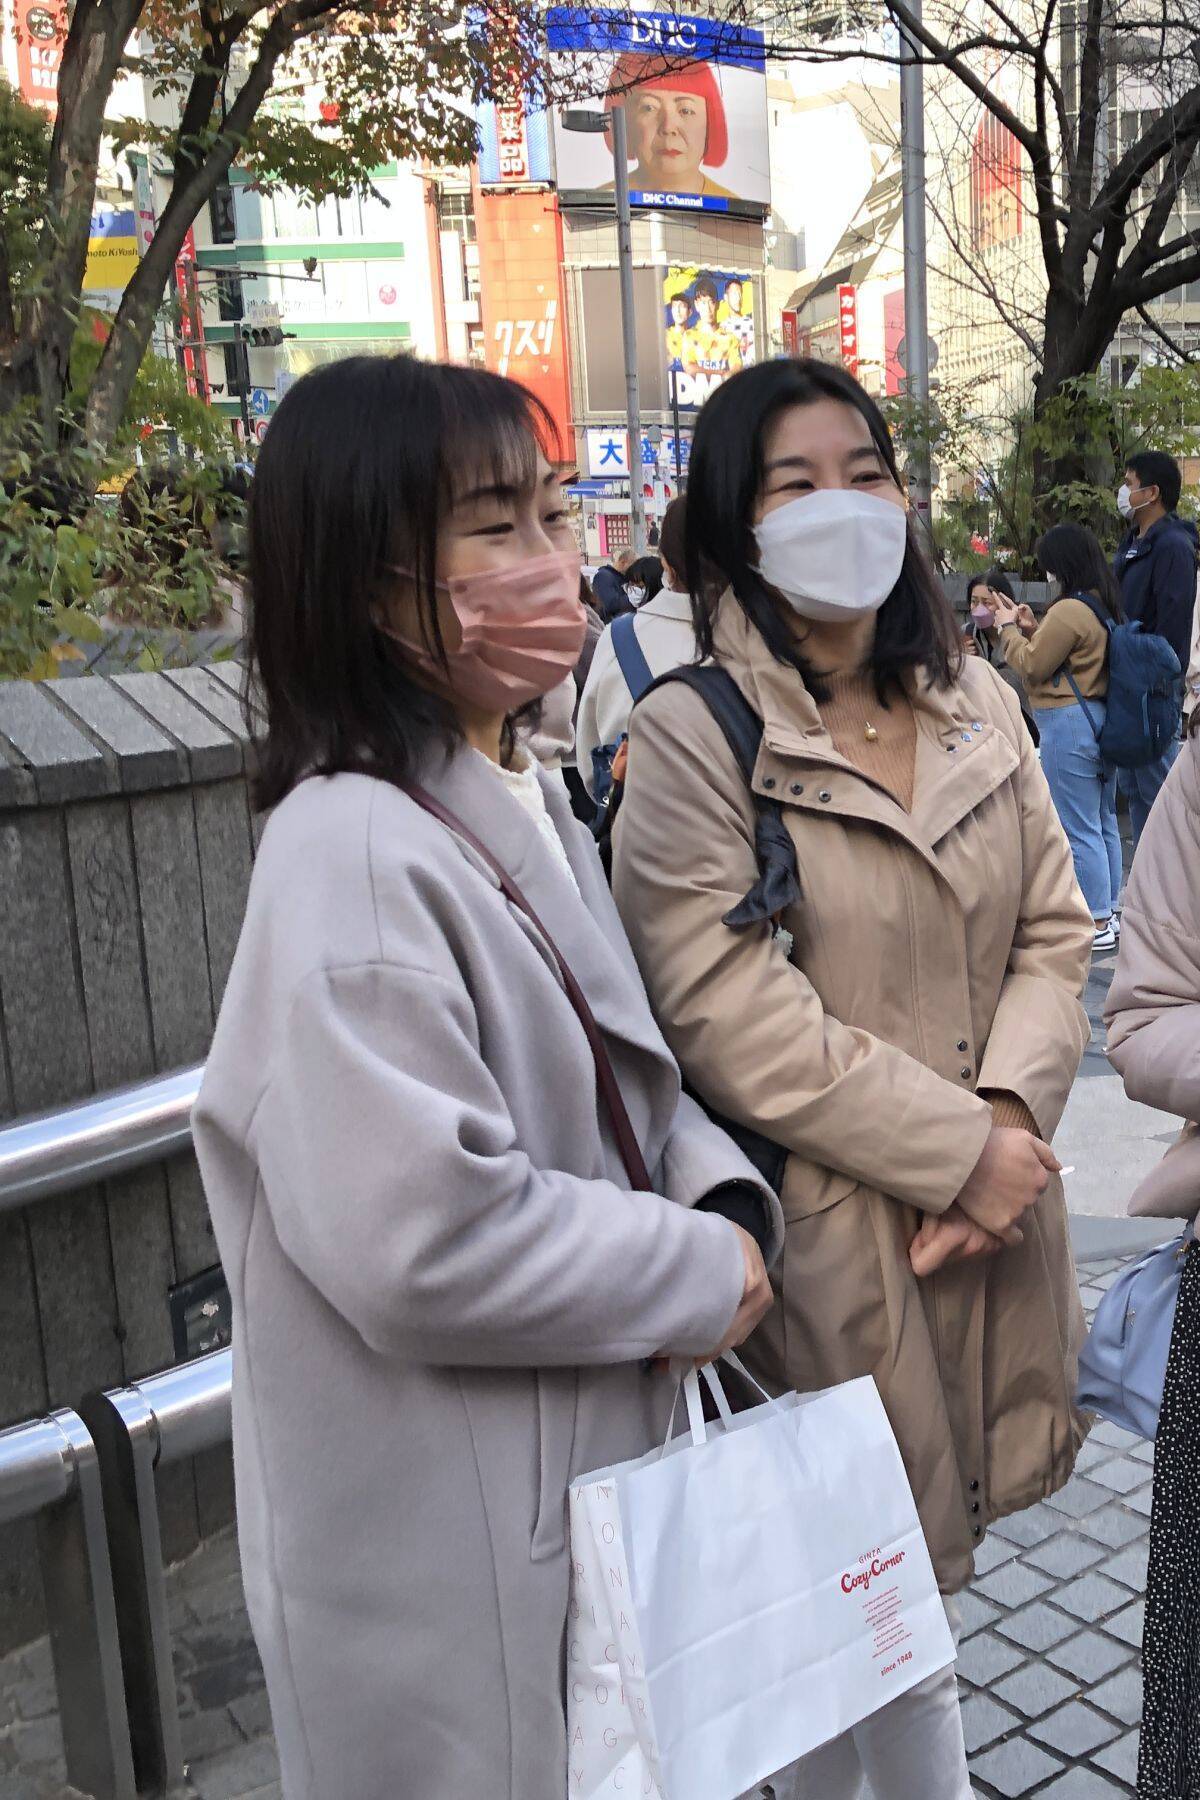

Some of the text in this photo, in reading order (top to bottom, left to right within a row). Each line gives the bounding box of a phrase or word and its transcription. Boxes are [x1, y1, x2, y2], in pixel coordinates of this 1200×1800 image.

[631, 16, 697, 48] DHC
[642, 192, 703, 207] DHC Channel
[494, 299, 557, 377] クスリ
[859, 1548, 881, 1564] GINZA
[841, 1551, 906, 1593] Cozy Corner
[880, 1651, 913, 1676] since 1948
